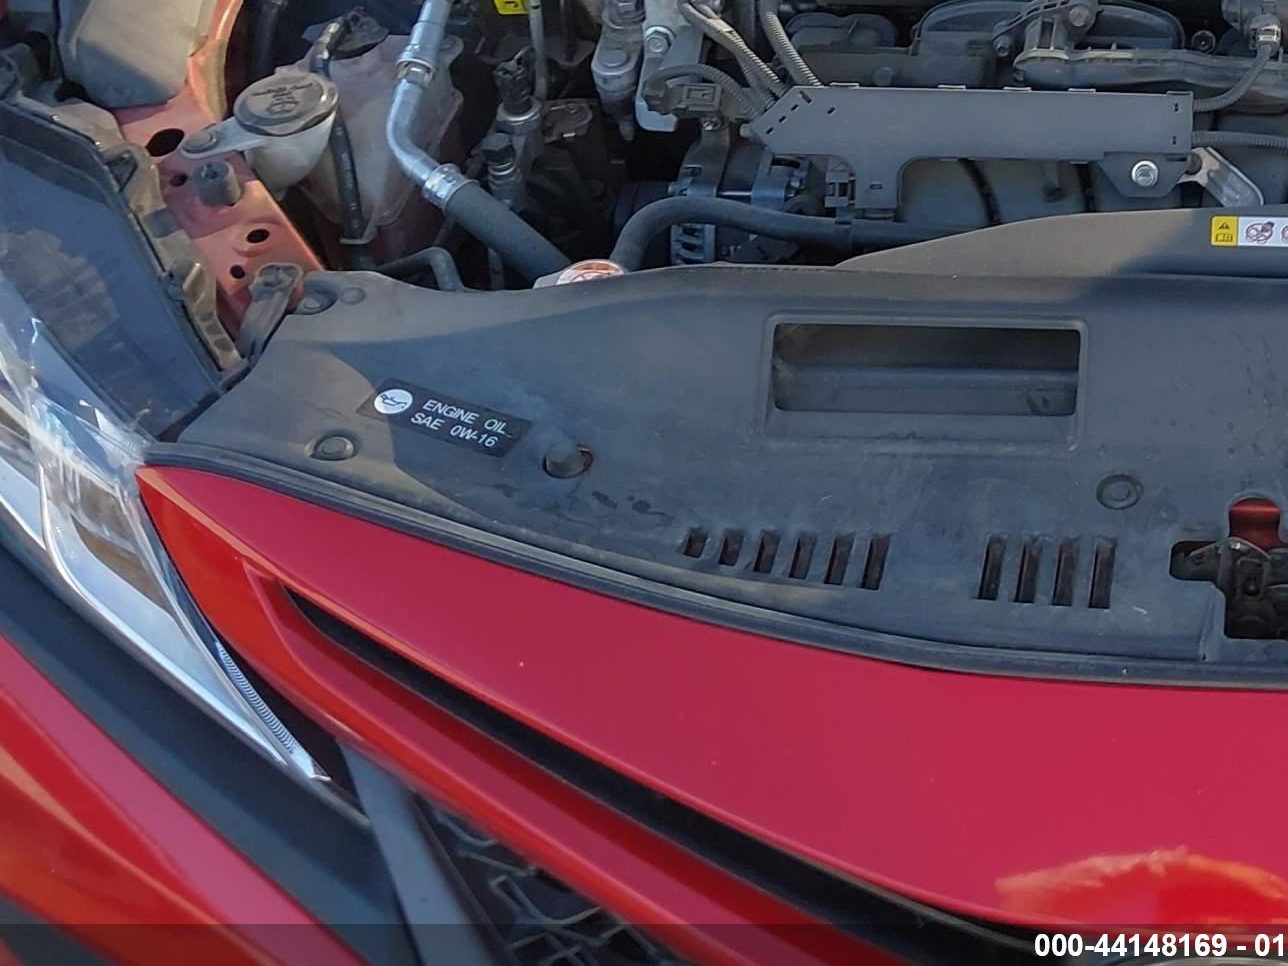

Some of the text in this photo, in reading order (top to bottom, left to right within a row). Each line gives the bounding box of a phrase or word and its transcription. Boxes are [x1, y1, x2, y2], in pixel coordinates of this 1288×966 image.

[410, 412, 499, 447] SAE 0W-16
[422, 399, 508, 434] ENGINE OIL
